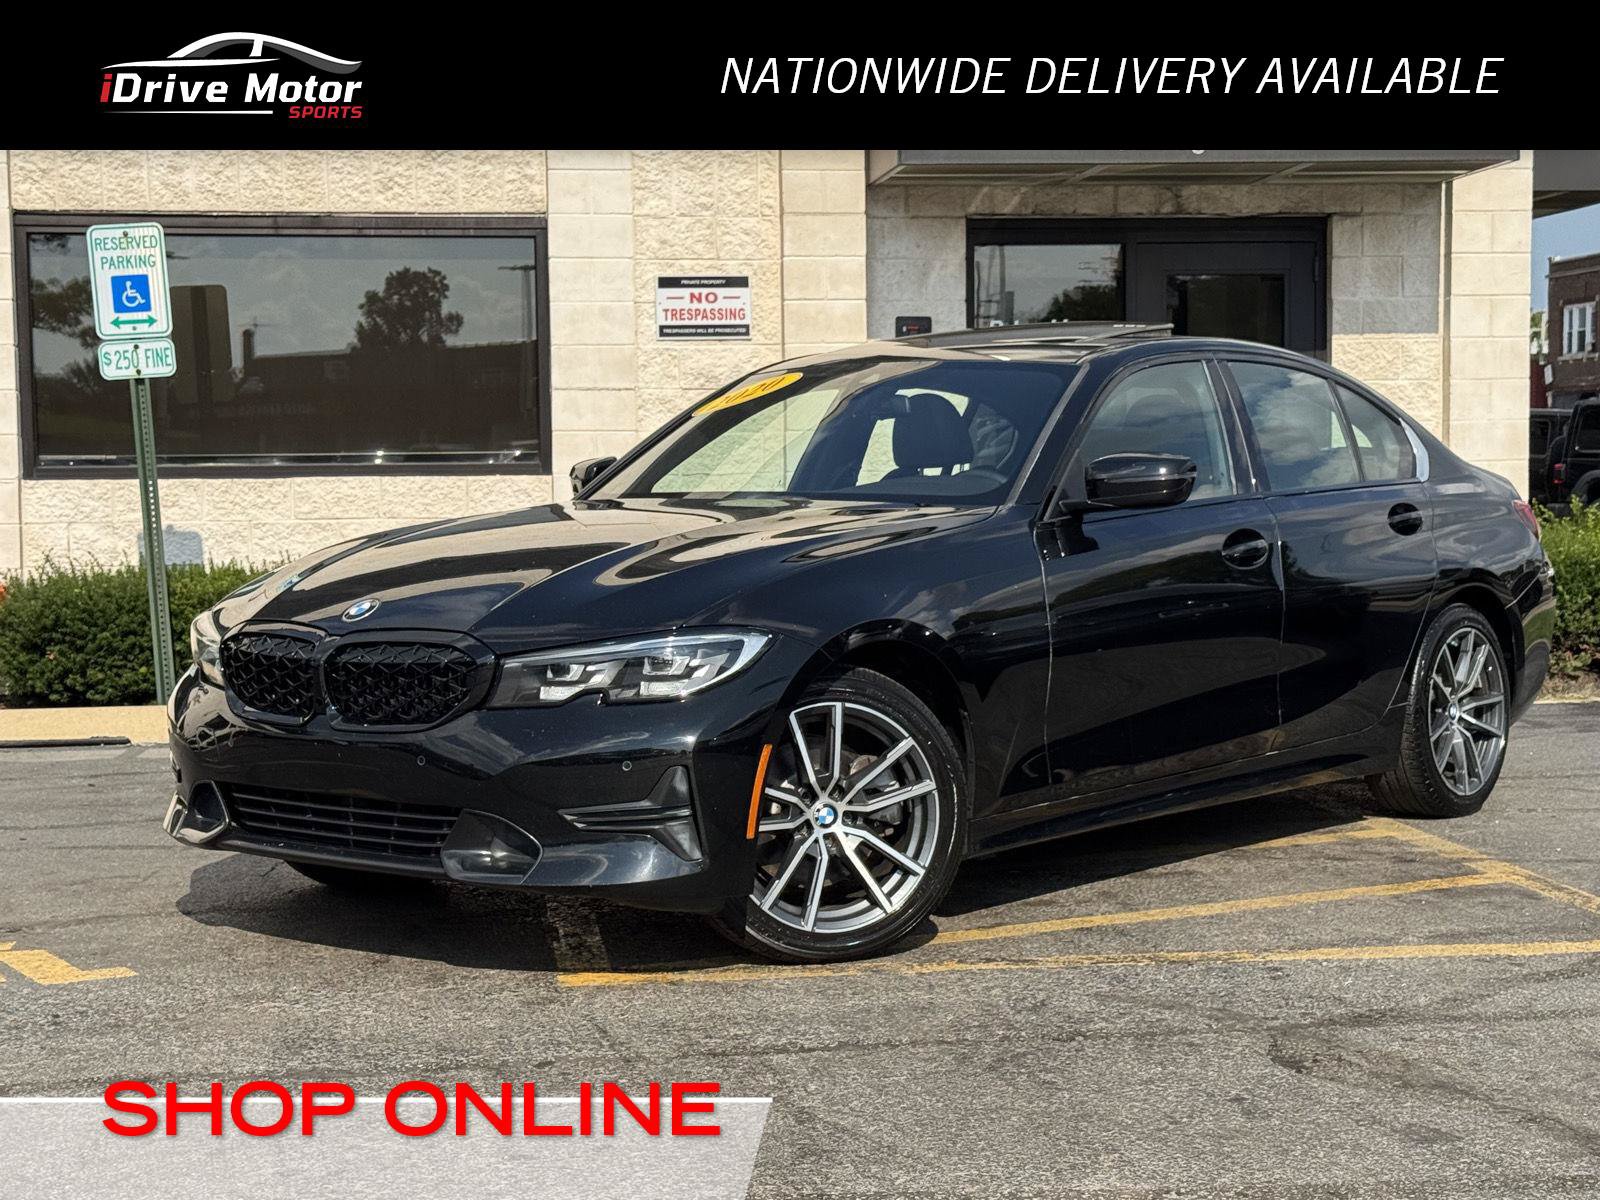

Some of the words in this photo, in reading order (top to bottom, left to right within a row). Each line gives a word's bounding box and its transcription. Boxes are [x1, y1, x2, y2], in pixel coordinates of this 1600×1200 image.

[94, 234, 158, 252] RESERVED
[100, 254, 156, 270] PARKING
[689, 292, 718, 304] NO
[662, 308, 746, 321] TRESPASSING
[144, 347, 172, 369] FINE
